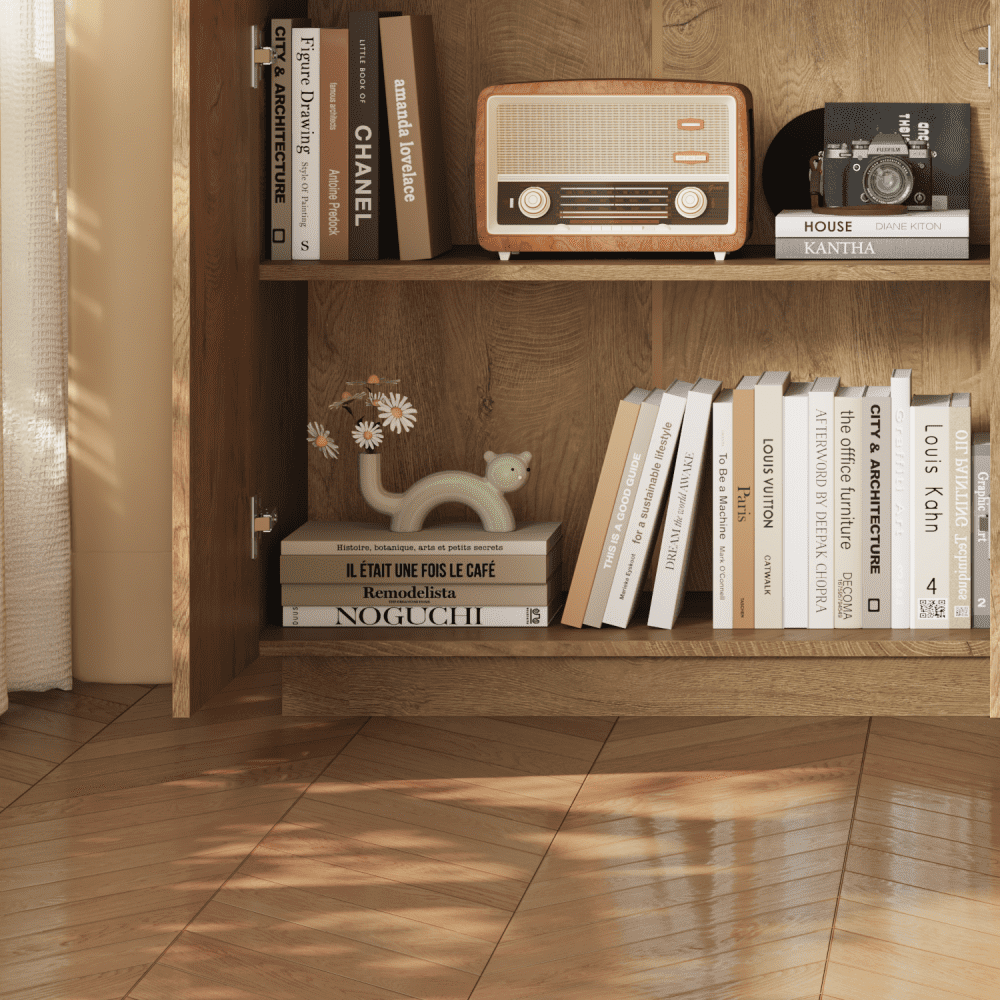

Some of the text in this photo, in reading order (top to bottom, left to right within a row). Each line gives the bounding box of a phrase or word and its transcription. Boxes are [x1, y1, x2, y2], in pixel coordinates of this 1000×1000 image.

[275, 26, 285, 204] CITY & ARCHITECTURE
[296, 37, 314, 155] Figure Drawing
[360, 93, 365, 103] OF
[394, 79, 417, 202] amanda lovelace
[355, 126, 372, 226] CHANEL
[300, 197, 308, 227] Painting
[329, 169, 340, 236] Antoine Predock
[804, 221, 852, 232] HOUSE
[804, 242, 875, 254] KANTHA
[841, 410, 854, 434] the
[719, 453, 727, 464] To
[719, 467, 727, 482] Be
[925, 424, 943, 532] Louis Kahn
[633, 531, 643, 544] for
[641, 463, 661, 519] sustainable
[654, 422, 672, 460] lifestyle
[763, 439, 773, 528] LOUIS VUITTON
[870, 404, 881, 574] CITY & ARCHITECTURE
[974, 472, 988, 511] Graphic
[604, 452, 641, 569] THIS IS A GOOD GUIDE
[665, 452, 694, 570] DREAM the world AWAKE
[719, 496, 728, 539] Machine
[737, 486, 751, 522] Paris
[816, 409, 827, 613] AFTERWORD BY DEEPAK CHOPRA
[841, 487, 855, 550] furniture
[337, 544, 371, 552] Histoire,
[375, 544, 416, 552] botanique,
[448, 544, 471, 552] petits
[347, 560, 495, 578] IL ÉTAIT UNE FOIS LE CAFÉ
[927, 577, 937, 594] 4
[363, 586, 456, 598] Remodelista
[842, 572, 852, 620] DECOMA
[978, 599, 986, 608] 2
[336, 607, 483, 625] NOGUCHI
